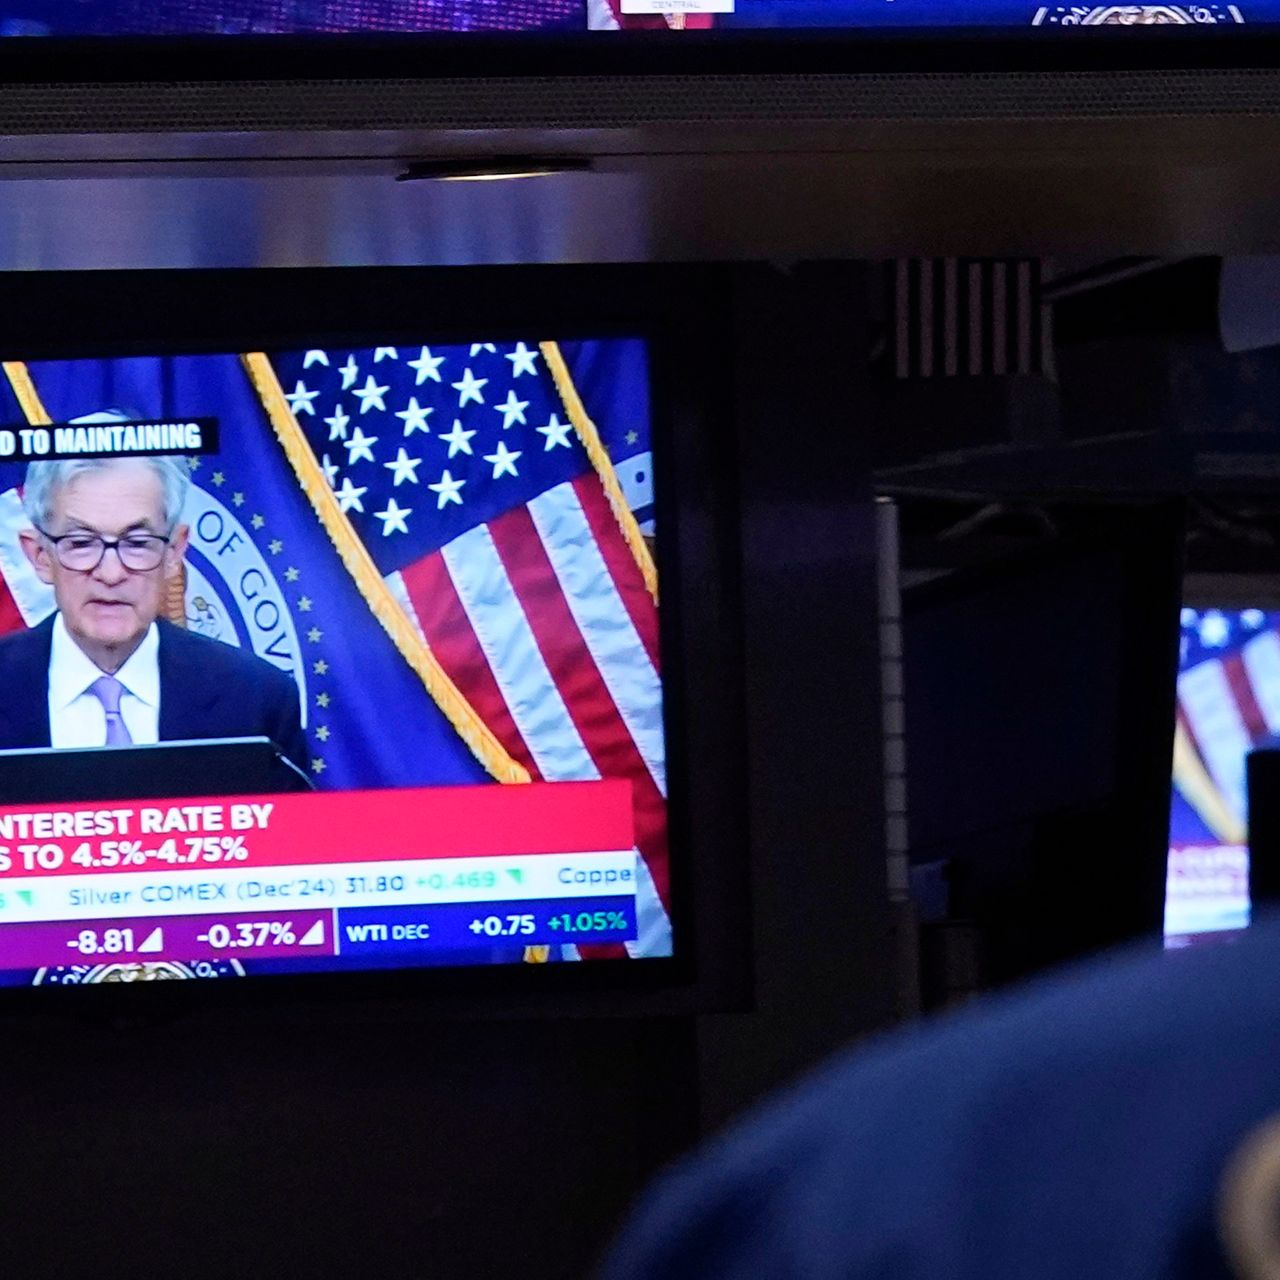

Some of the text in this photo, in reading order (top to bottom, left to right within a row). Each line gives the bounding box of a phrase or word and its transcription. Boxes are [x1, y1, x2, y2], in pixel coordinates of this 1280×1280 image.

[21, 430, 49, 454] TO
[54, 424, 200, 454] MAINTAINING
[141, 808, 225, 834] RATE
[231, 804, 273, 830] BY
[19, 845, 64, 870] TO
[71, 836, 248, 868] 4.5%-4.75%
[67, 932, 135, 955] -8.81
[197, 923, 295, 947] -0.37%
[347, 923, 388, 941] WTI
[392, 924, 429, 940] DEC
[470, 915, 535, 936] +0.75
[548, 912, 626, 933] +1.05%
